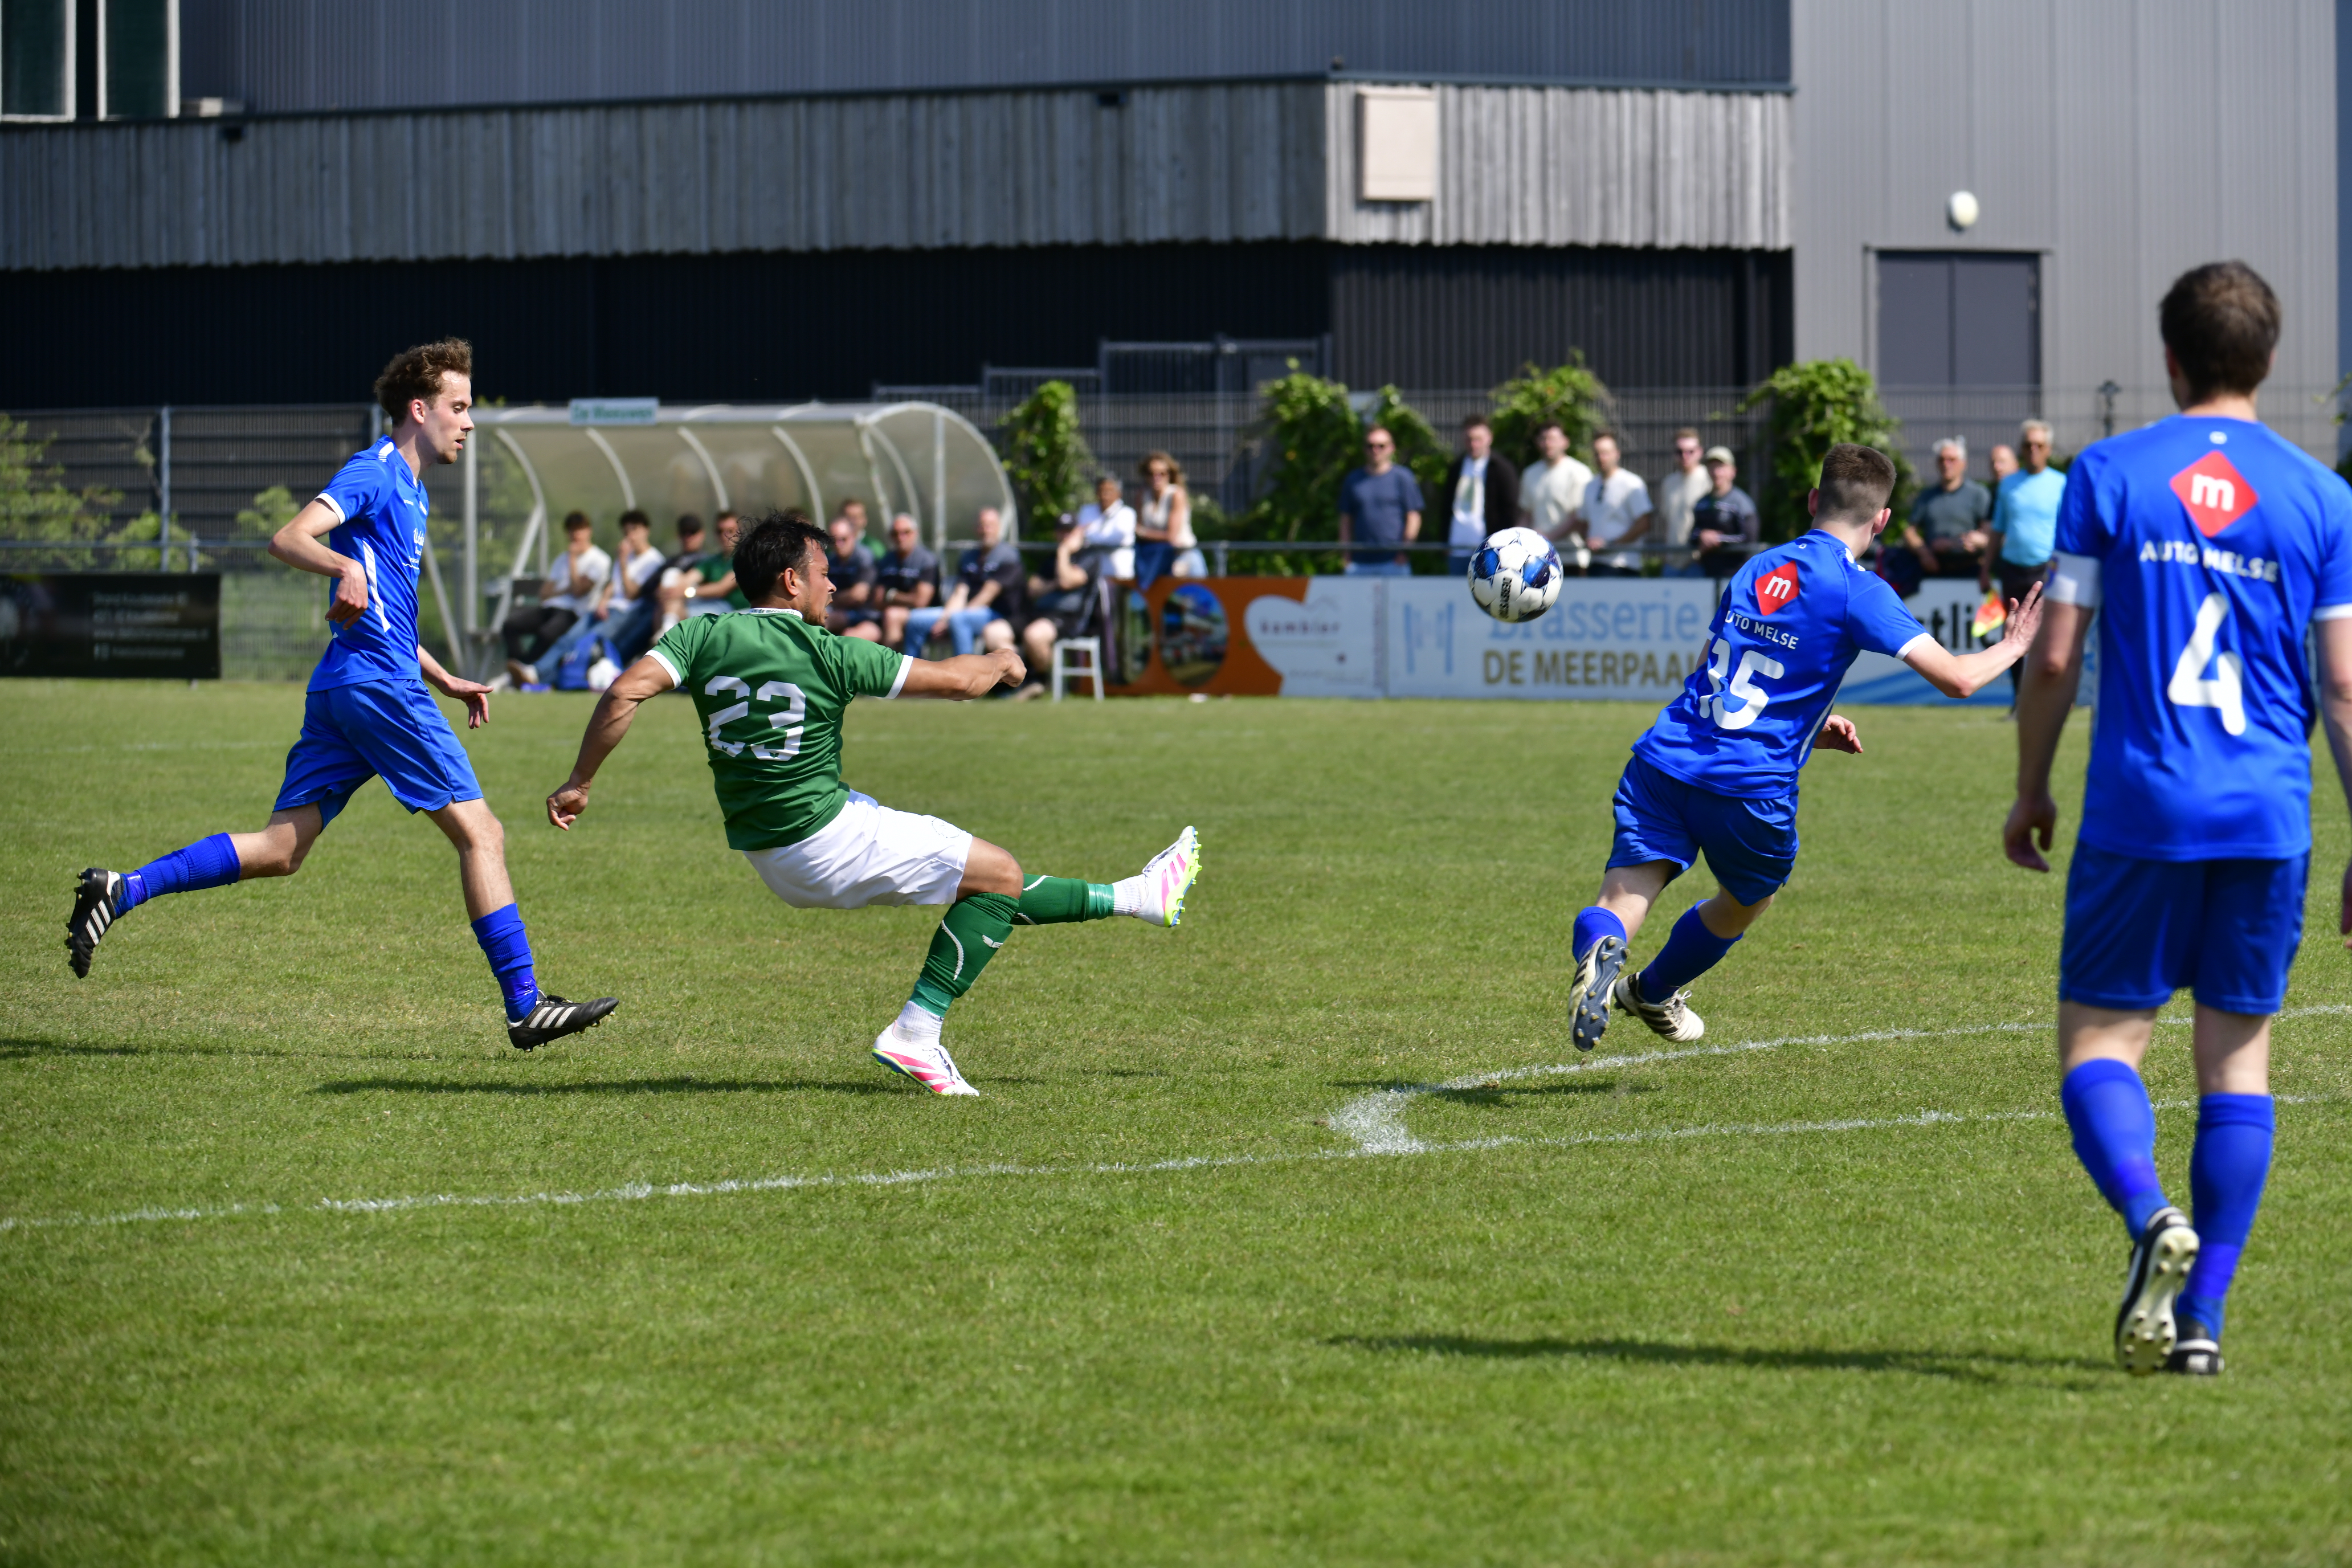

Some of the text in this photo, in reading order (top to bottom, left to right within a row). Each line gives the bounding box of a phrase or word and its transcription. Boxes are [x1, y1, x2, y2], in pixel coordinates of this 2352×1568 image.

[2191, 473, 2235, 512] m
[2139, 540, 2278, 583] AUTO MELSE
[1764, 576, 1791, 599] m
[1725, 610, 1799, 650] UTO MELSE
[1484, 649, 1525, 685] DE
[2167, 591, 2246, 736] 4
[705, 675, 806, 762] 23
